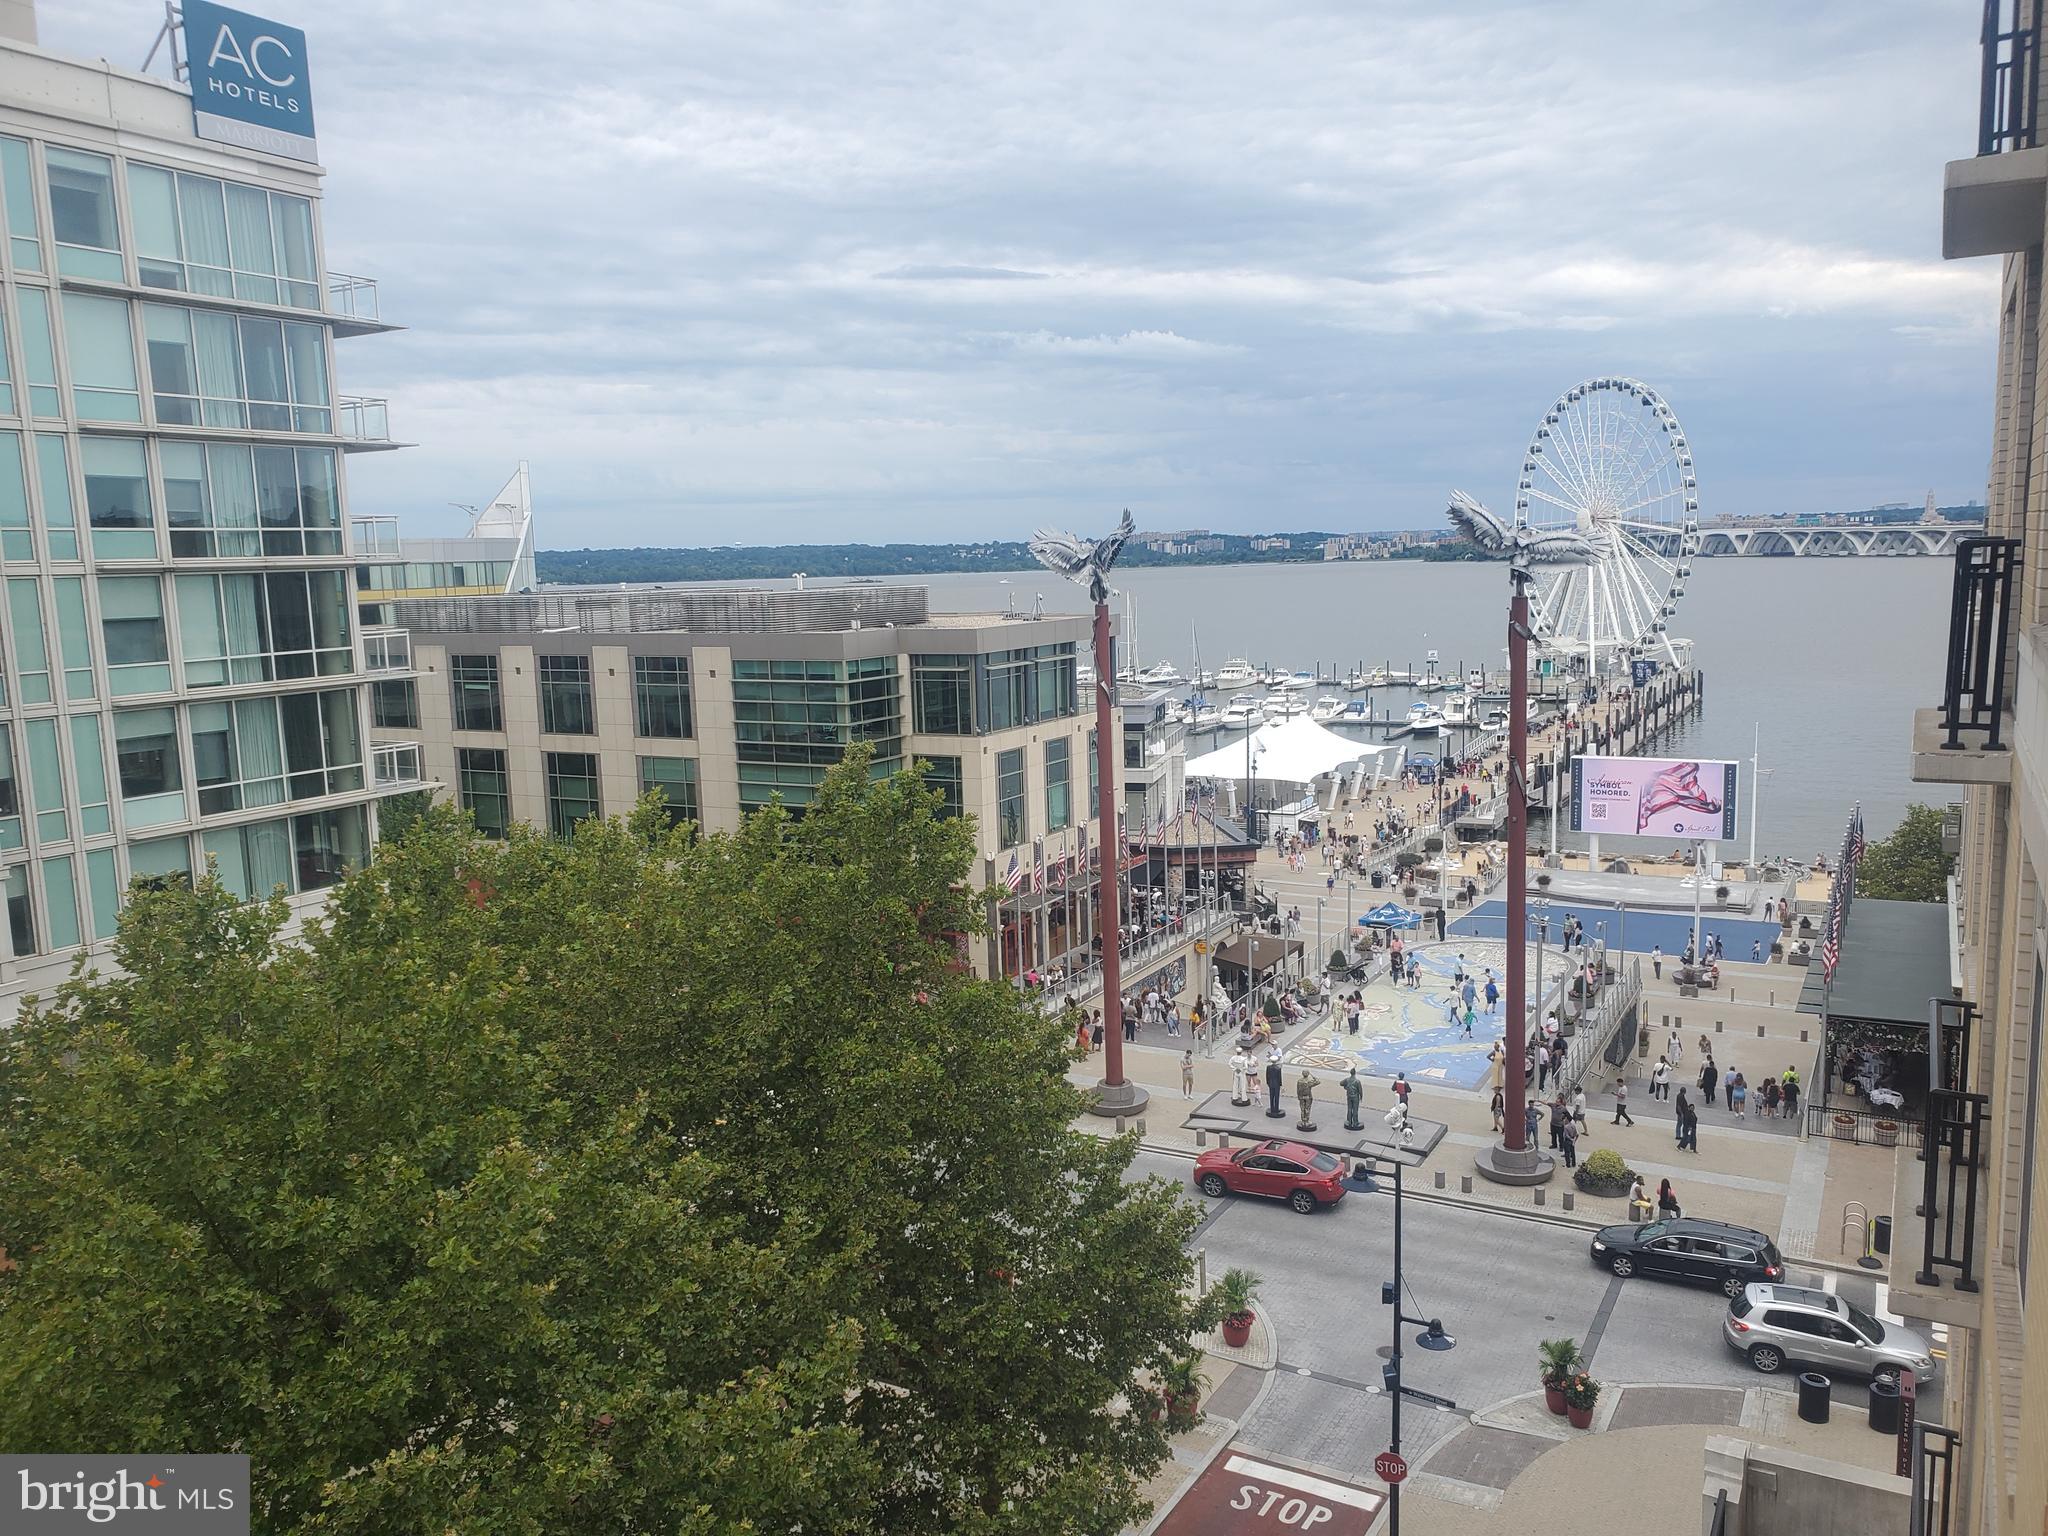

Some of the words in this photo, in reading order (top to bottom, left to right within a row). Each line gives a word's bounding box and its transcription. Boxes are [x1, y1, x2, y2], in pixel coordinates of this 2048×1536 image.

[208, 24, 295, 87] AC
[208, 77, 299, 113] HOTELS
[1376, 1460, 1406, 1476] STOP
[1229, 1485, 1333, 1531] STOP
